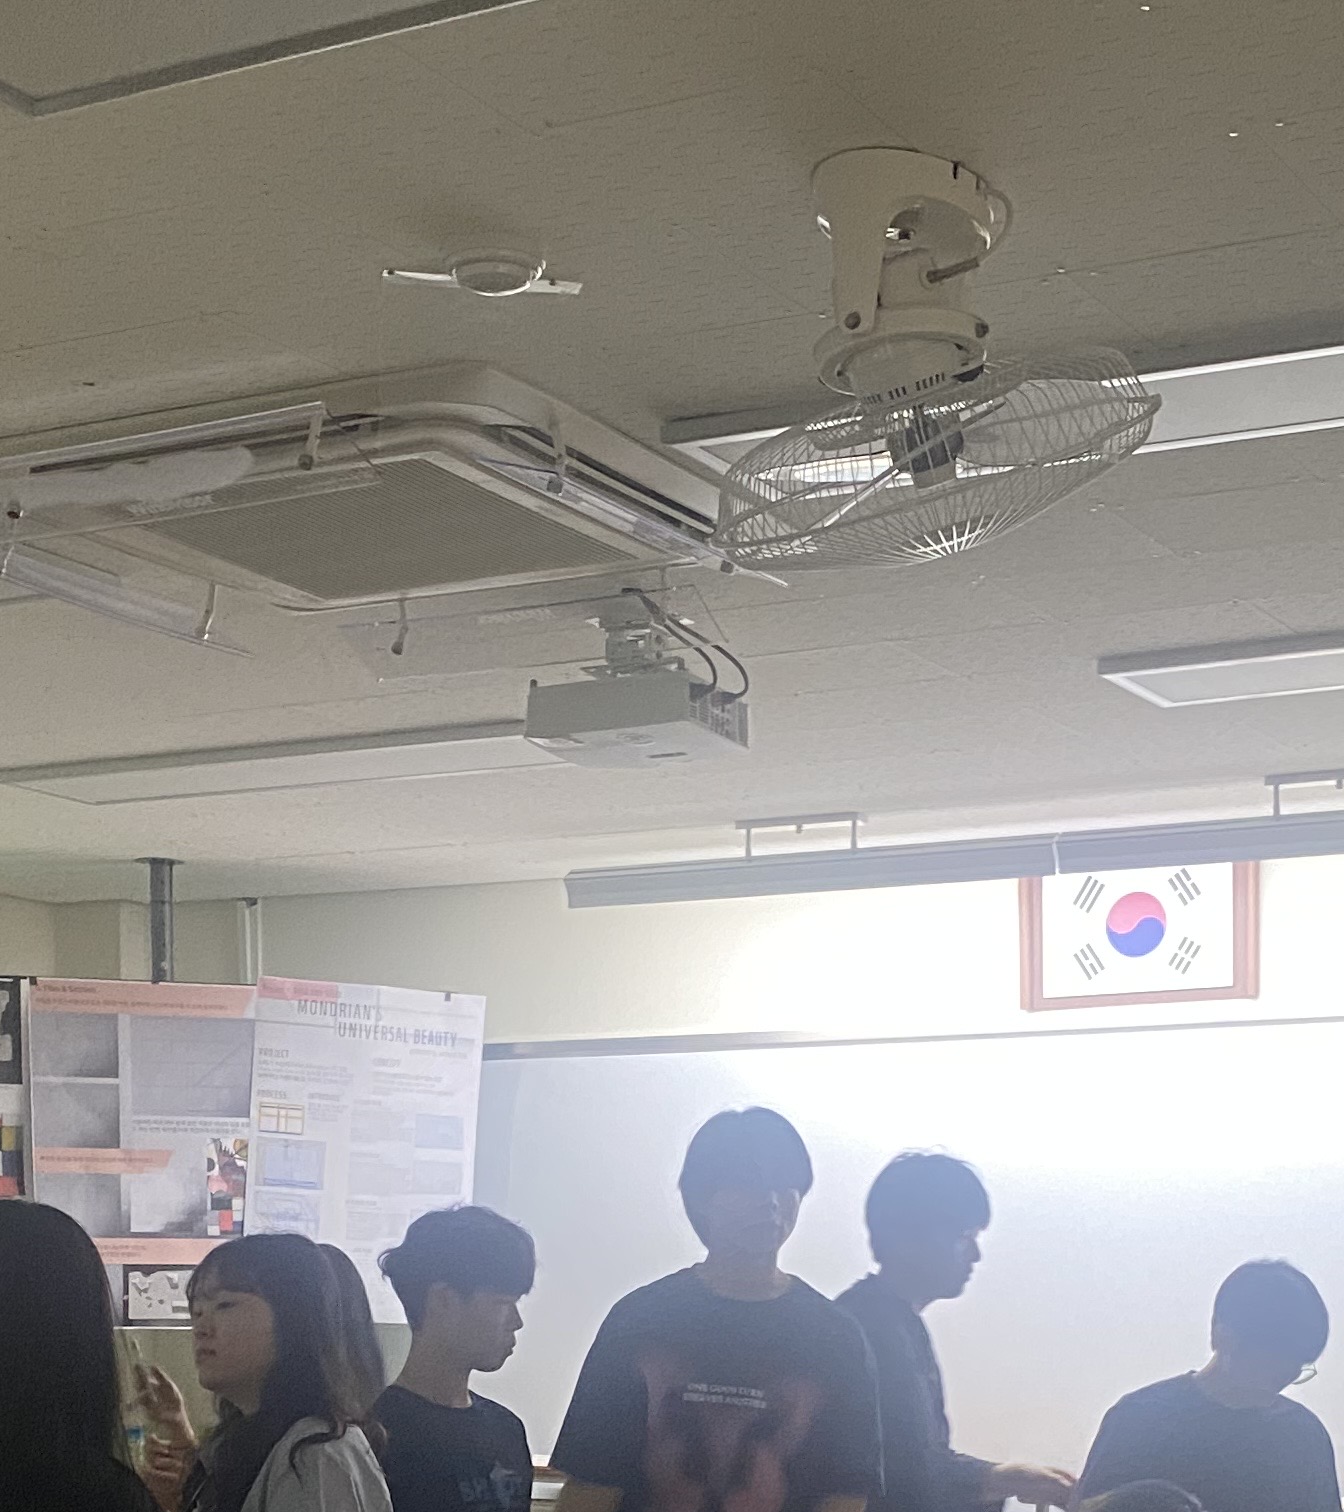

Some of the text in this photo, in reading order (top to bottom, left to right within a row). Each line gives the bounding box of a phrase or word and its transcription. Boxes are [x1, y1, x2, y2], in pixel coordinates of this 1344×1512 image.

[297, 999, 382, 1022] MONDRIAN'S
[338, 1021, 457, 1047] UNIVERSAL BEAUTY
